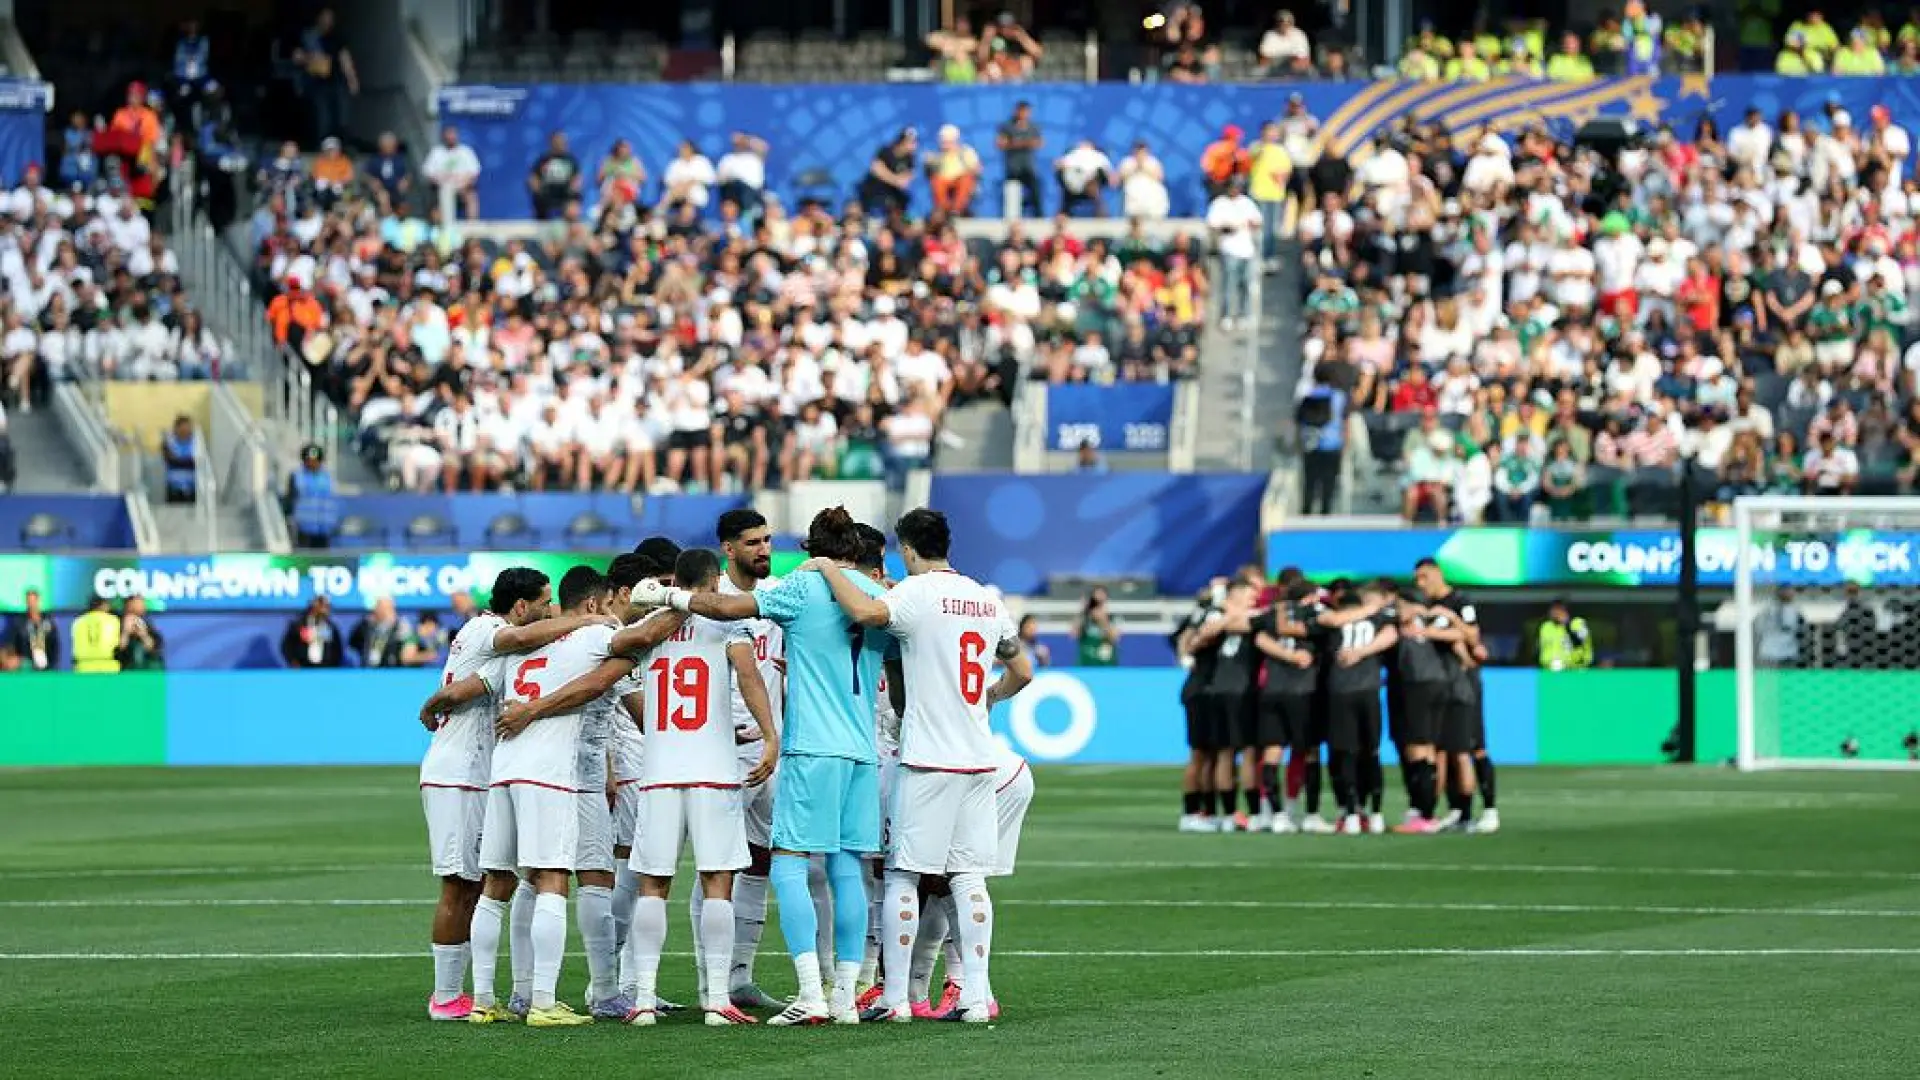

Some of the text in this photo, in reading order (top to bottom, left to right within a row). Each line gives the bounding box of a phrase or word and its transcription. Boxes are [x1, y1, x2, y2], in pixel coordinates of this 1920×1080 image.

[1568, 536, 1777, 573] COUNTOWN
[1785, 540, 1829, 573] TO
[309, 565, 352, 597] TO
[1342, 620, 1375, 650] 10
[514, 657, 548, 702] 5
[959, 631, 986, 705] 6
[649, 656, 710, 731] 19
